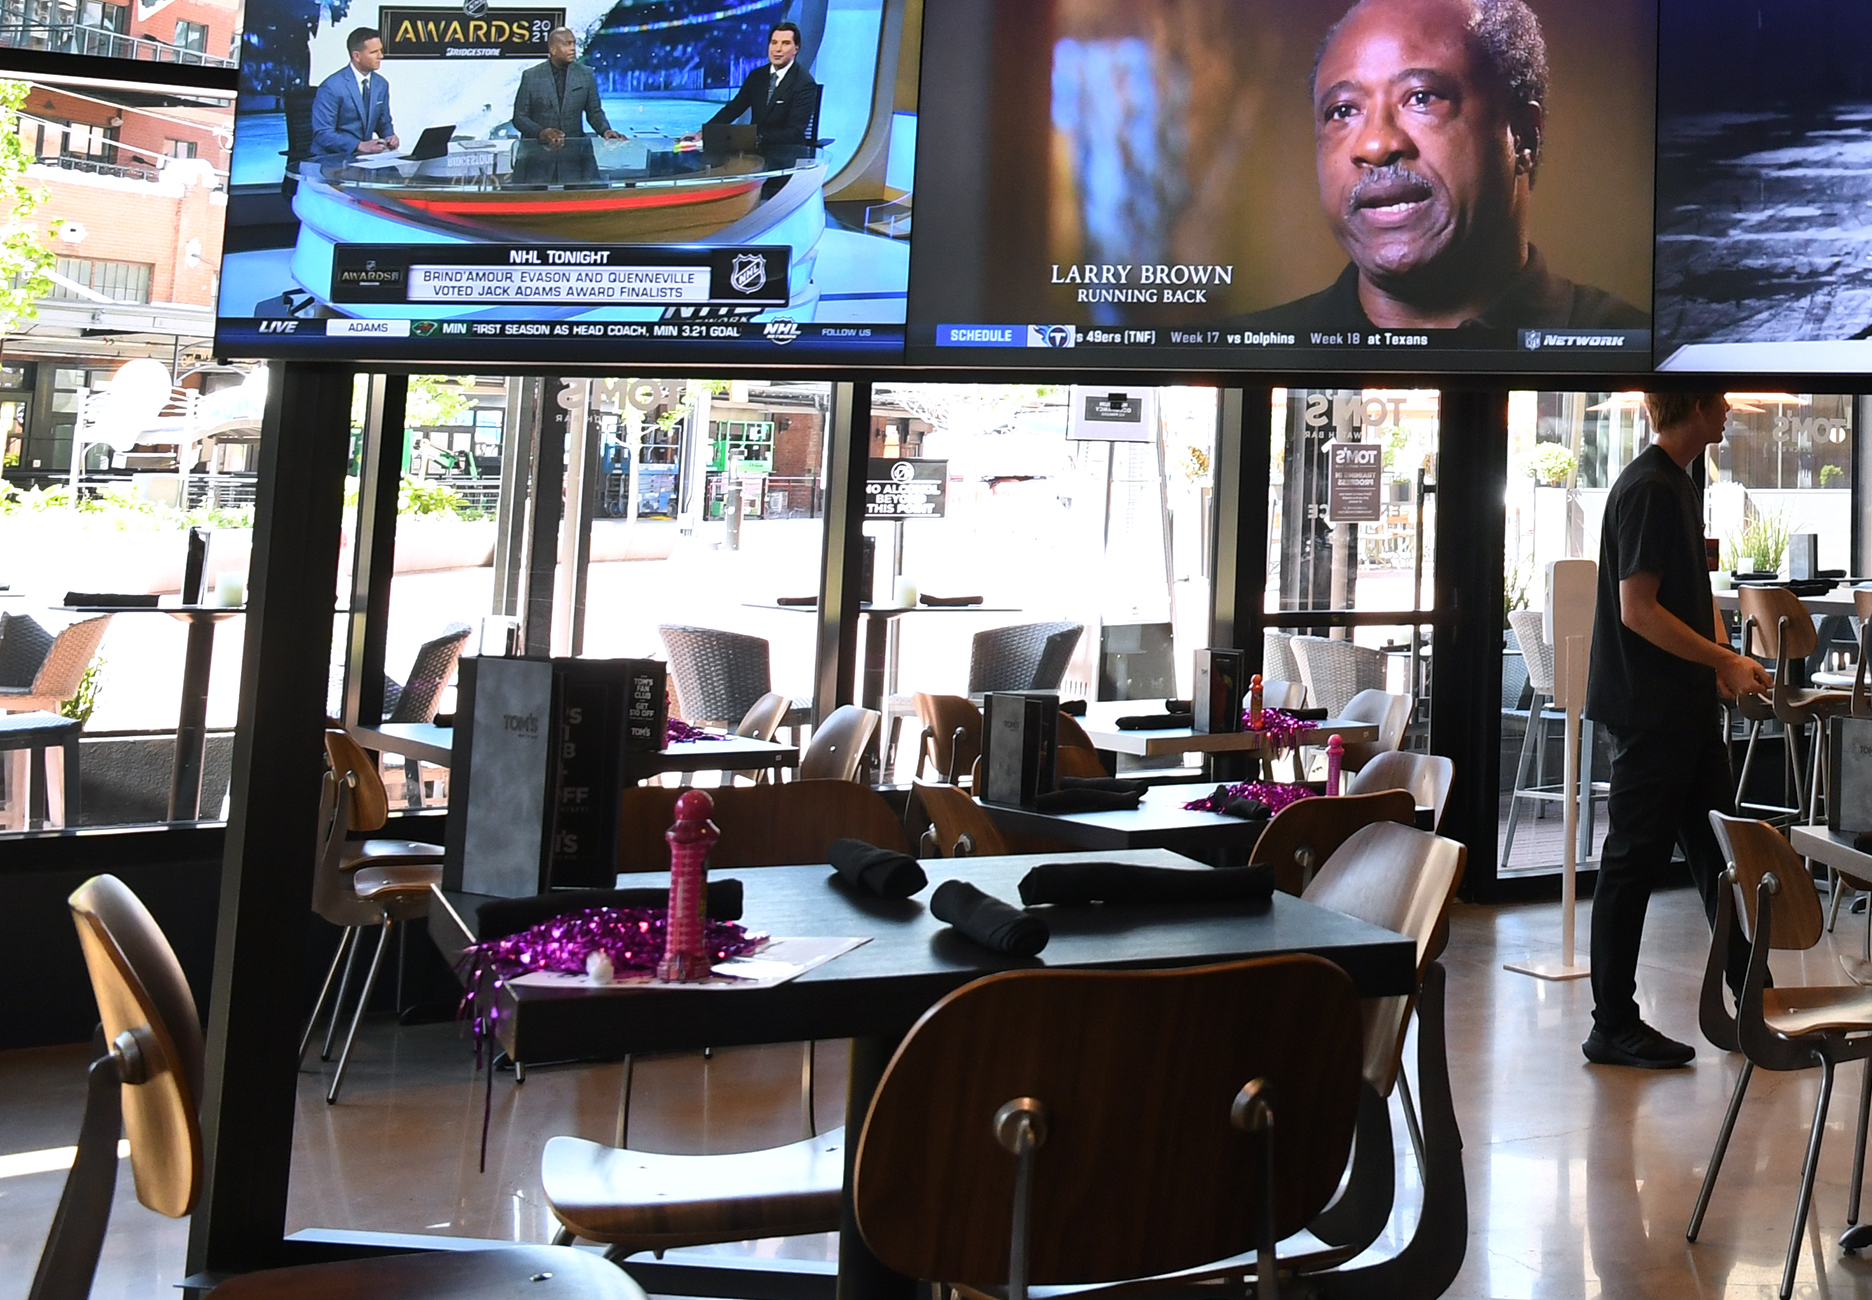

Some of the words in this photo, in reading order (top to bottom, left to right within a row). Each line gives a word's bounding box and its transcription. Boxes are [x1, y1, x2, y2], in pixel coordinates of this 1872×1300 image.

[395, 20, 530, 43] AWARDS
[1051, 265, 1132, 284] LARRY
[1140, 265, 1233, 285] BROWN
[1077, 289, 1158, 302] RUNNING
[1163, 289, 1207, 303] BACK
[950, 329, 1012, 342] SCHEDULE
[1086, 330, 1121, 343] 49ers
[1124, 330, 1156, 345] (TNF)
[1170, 331, 1202, 344] Week
[1206, 331, 1220, 344] 17
[1227, 334, 1241, 344] vs
[1244, 332, 1295, 347] Dolphins
[1310, 332, 1343, 345] Week
[1347, 332, 1360, 345] 18
[1367, 333, 1381, 345] at
[1384, 333, 1428, 345] Texans
[866, 503, 895, 514] THIS
[503, 713, 539, 734] TOM'S
